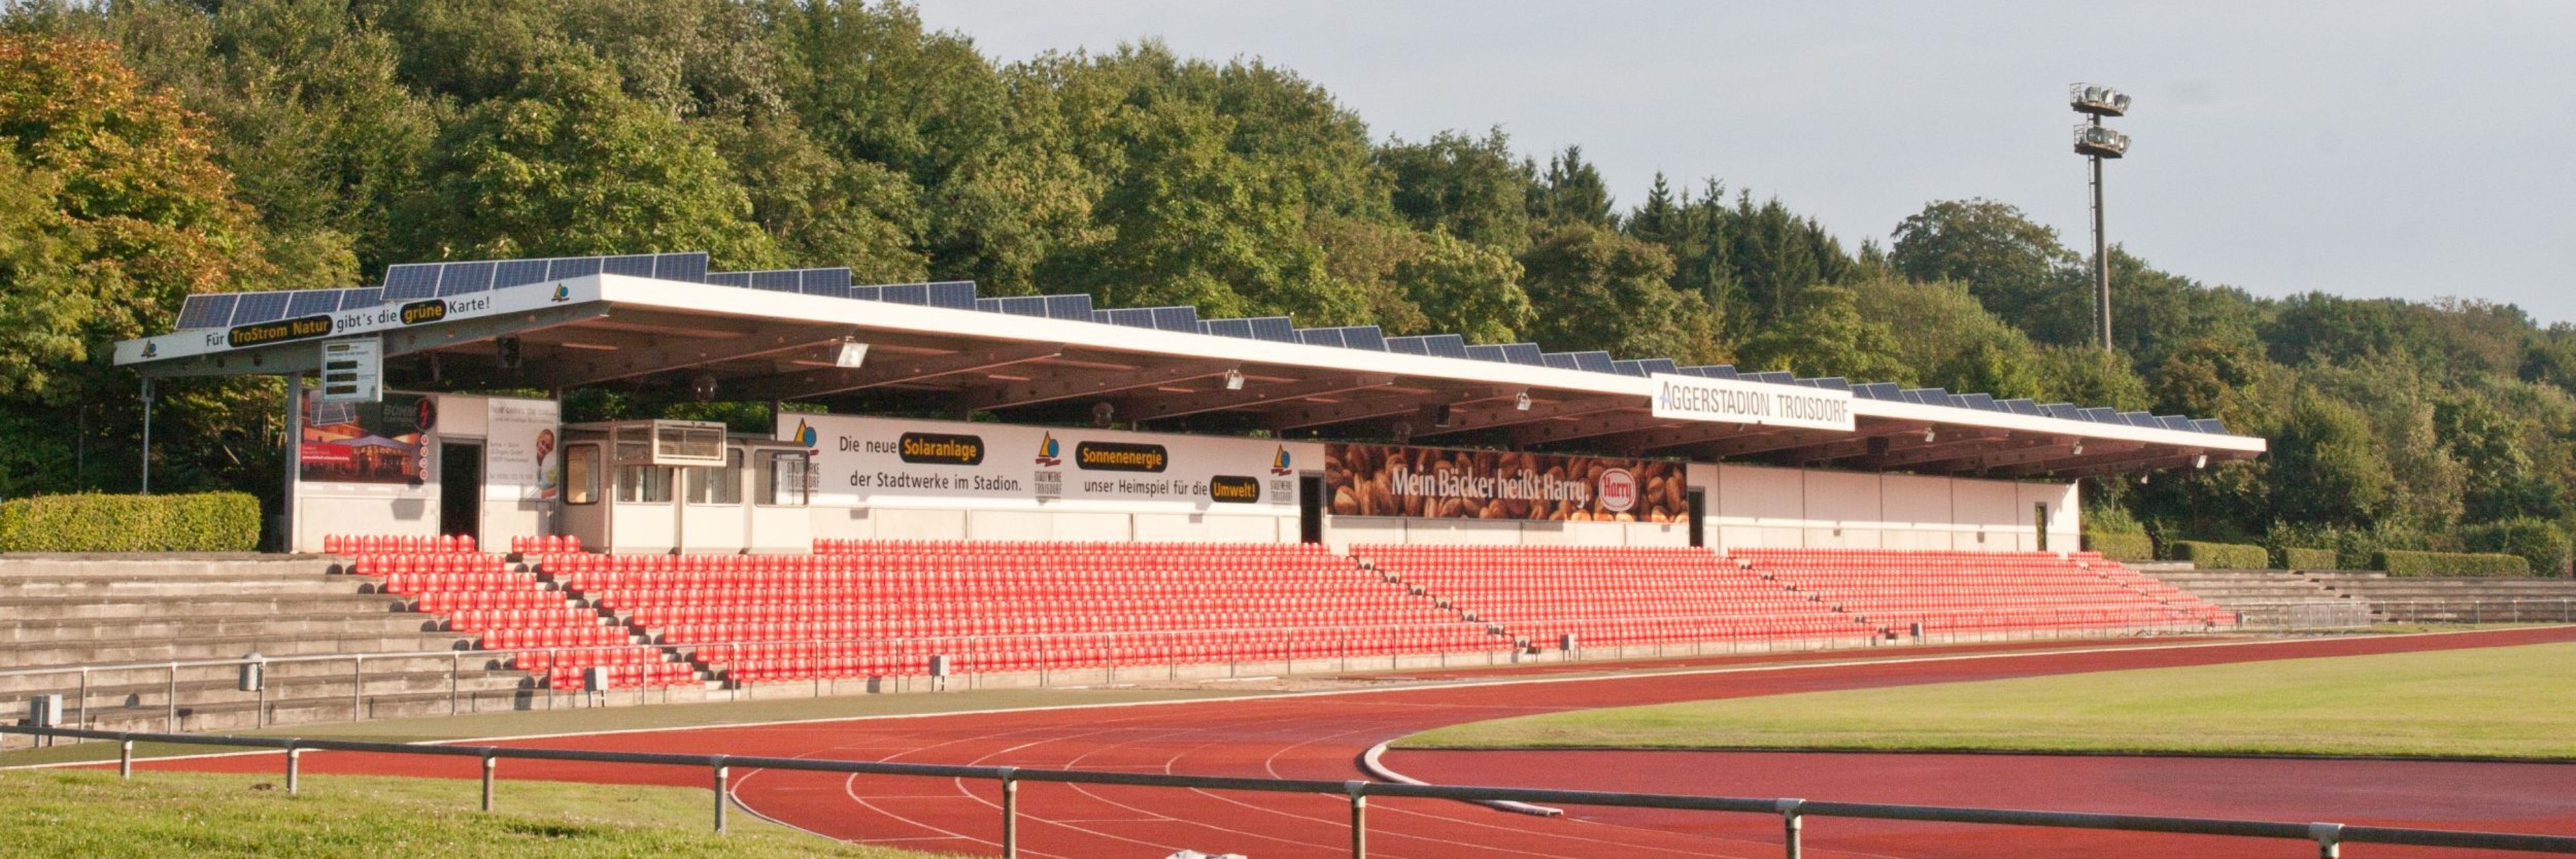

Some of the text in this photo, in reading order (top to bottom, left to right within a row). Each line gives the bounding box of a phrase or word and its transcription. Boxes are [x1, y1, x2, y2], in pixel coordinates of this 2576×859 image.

[207, 296, 490, 347] Für TroStrom Natur gibt's die grüne Karte!
[1661, 381, 1849, 423] AGGERSTADION TROISDORF
[839, 436, 977, 461] Die neue Solaranlage
[1082, 447, 1163, 469] Sonnenenergie
[850, 470, 1022, 491] der Stadtwerke im Stadion.
[1084, 479, 1256, 498] unser Heimspiel für die Umwelt!
[1392, 467, 1590, 508] Mein Bäcker heißt Harry.
[1603, 475, 1632, 504] Harry
